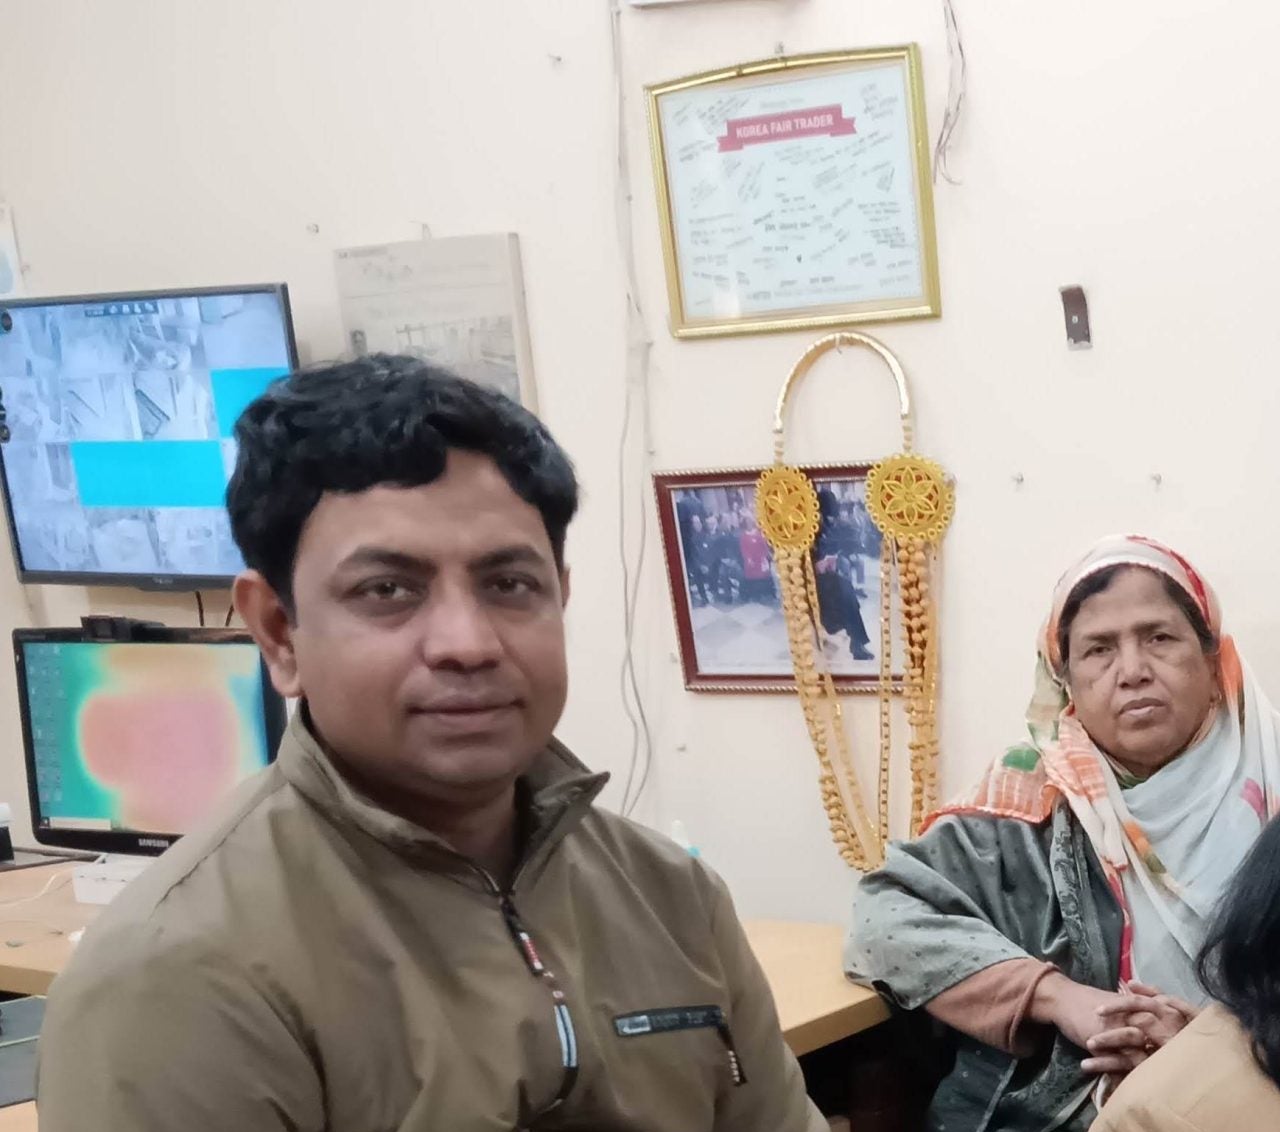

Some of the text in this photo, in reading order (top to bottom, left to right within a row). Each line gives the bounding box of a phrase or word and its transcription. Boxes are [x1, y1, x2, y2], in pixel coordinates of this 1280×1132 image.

[736, 114, 834, 139] KOREA FAIR TRADER
